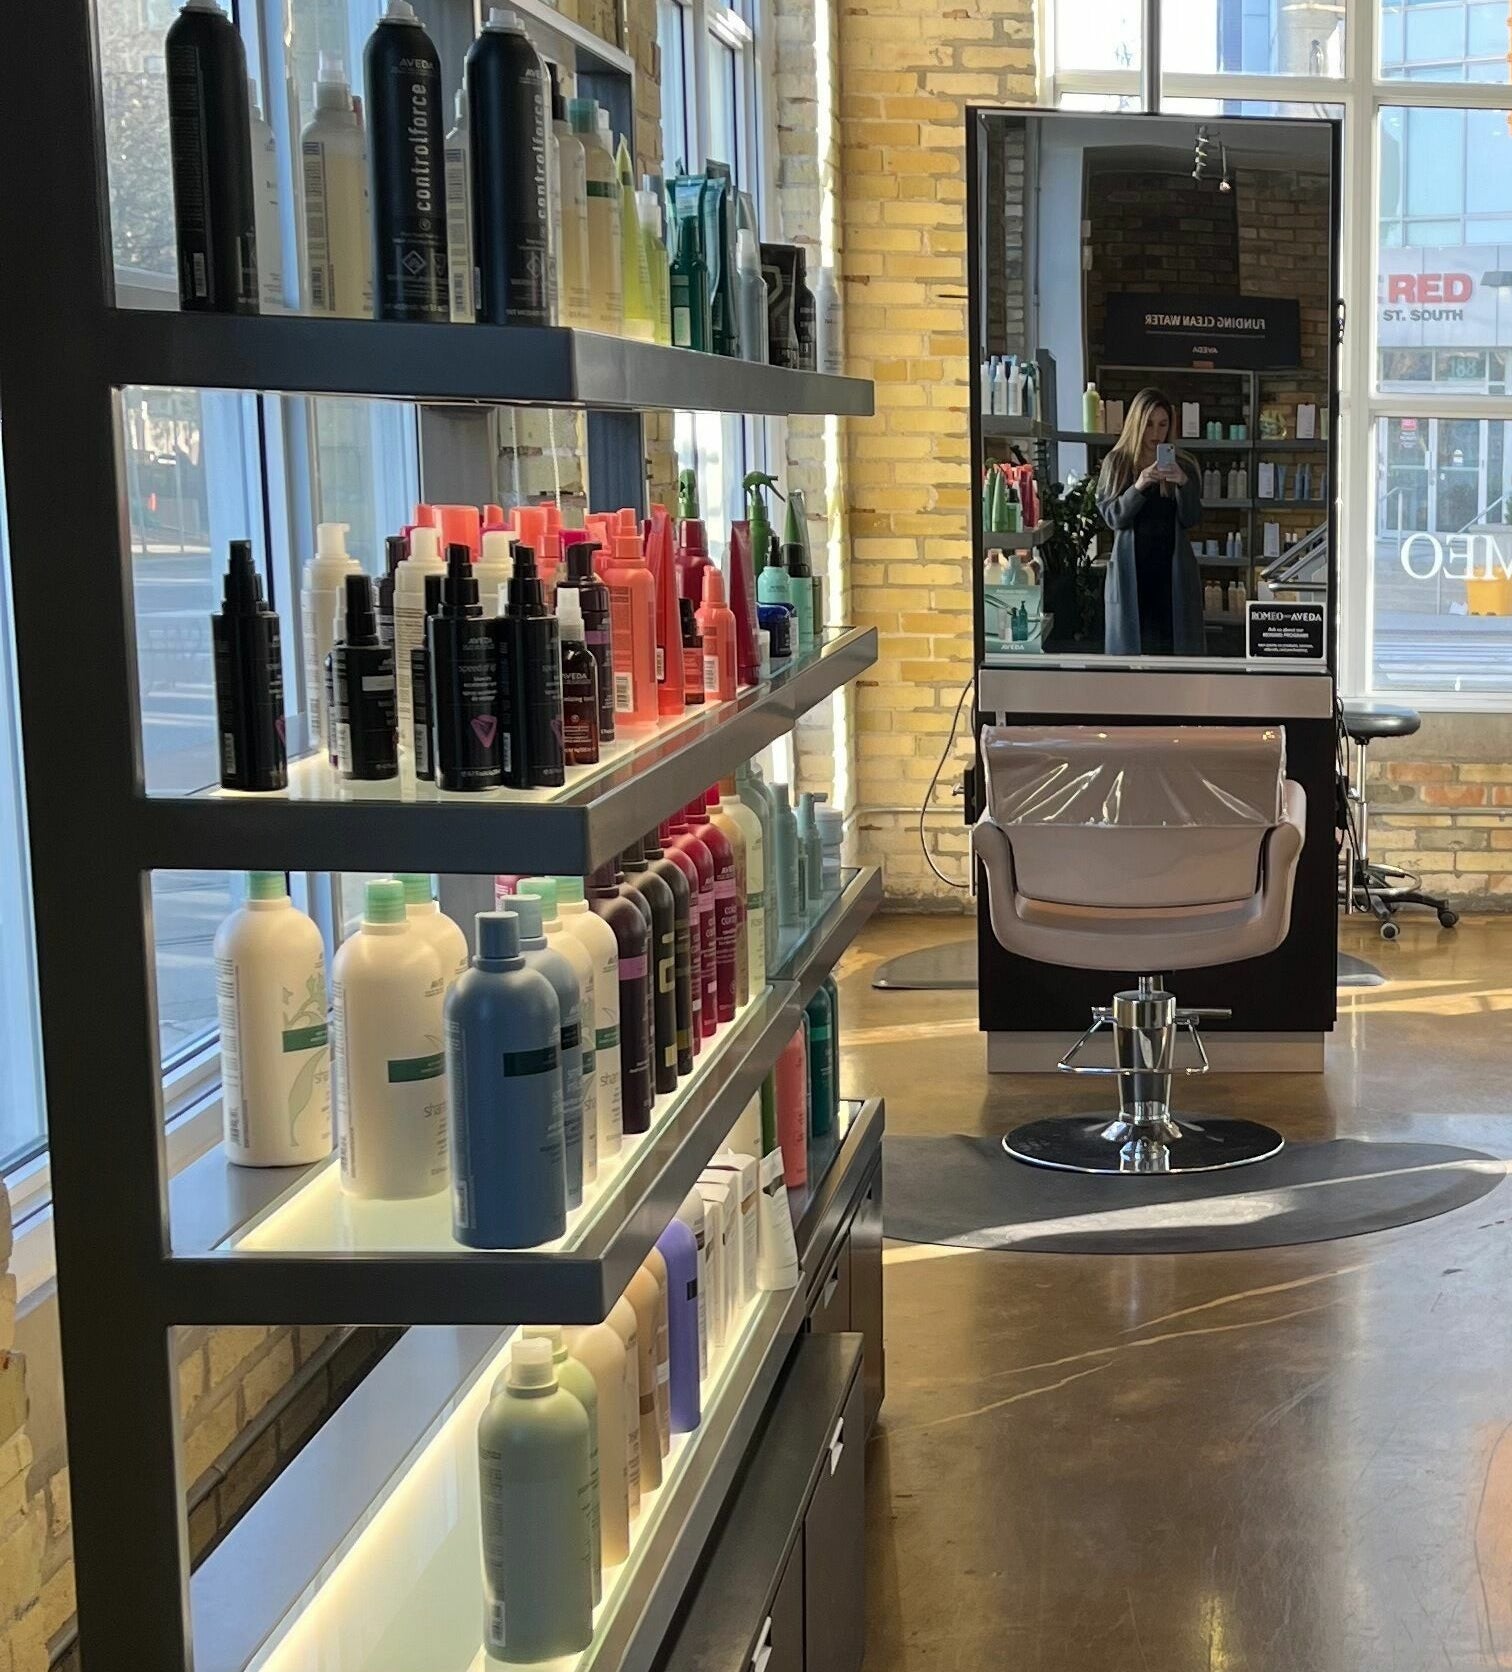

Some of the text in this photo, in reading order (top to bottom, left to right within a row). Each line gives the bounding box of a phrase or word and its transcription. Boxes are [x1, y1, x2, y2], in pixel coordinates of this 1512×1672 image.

[408, 83, 432, 213] controlforce
[1388, 273, 1473, 304] RED
[1383, 309, 1464, 321] ST. SOUTH
[1251, 611, 1322, 622] ROMEO AVEDA
